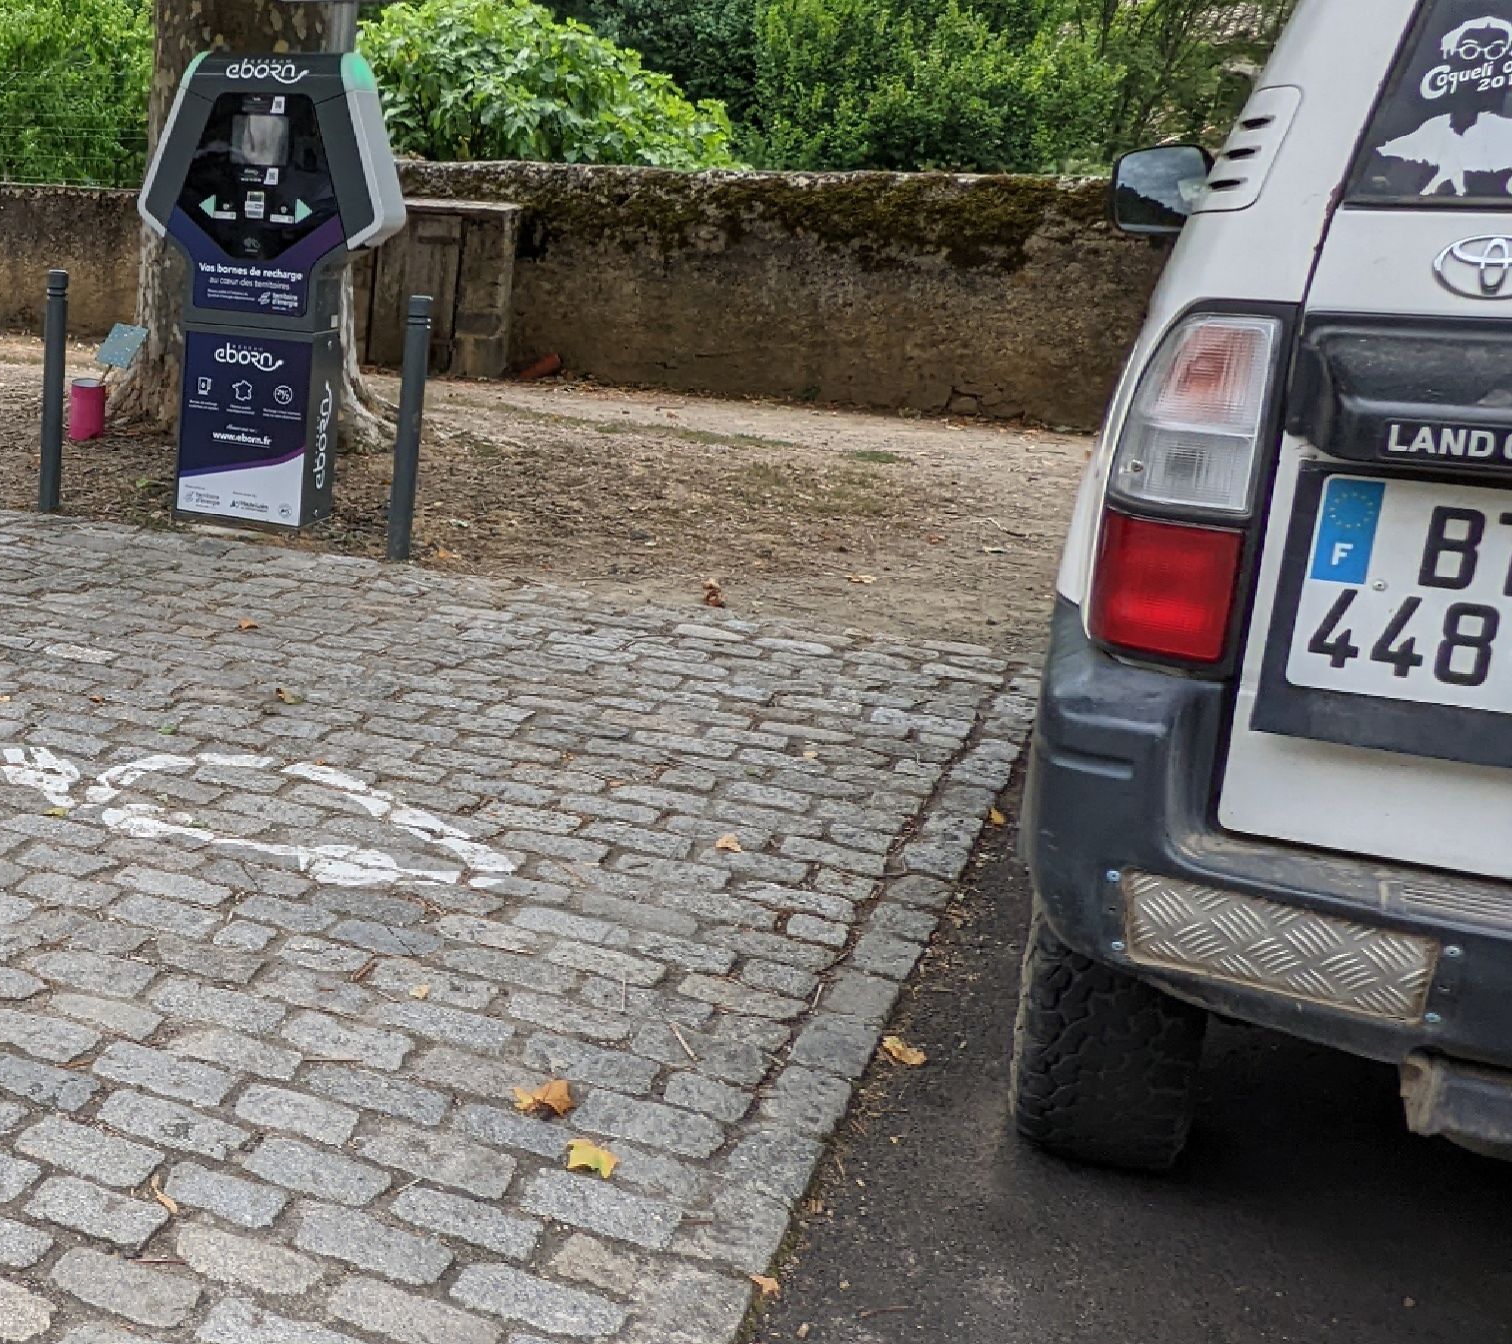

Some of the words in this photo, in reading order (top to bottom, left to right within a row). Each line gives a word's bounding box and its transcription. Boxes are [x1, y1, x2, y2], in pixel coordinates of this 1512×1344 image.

[226, 58, 309, 84] eborn
[217, 263, 248, 276] bornes
[250, 266, 261, 276] de
[263, 269, 303, 281] recharge
[214, 342, 284, 371] eborn
[212, 431, 271, 446] www.eborn.fr
[313, 379, 332, 490] eborn
[1388, 424, 1496, 457] LAND
[1330, 542, 1354, 566] F
[1418, 505, 1512, 597] B
[1307, 588, 1501, 687] 448
